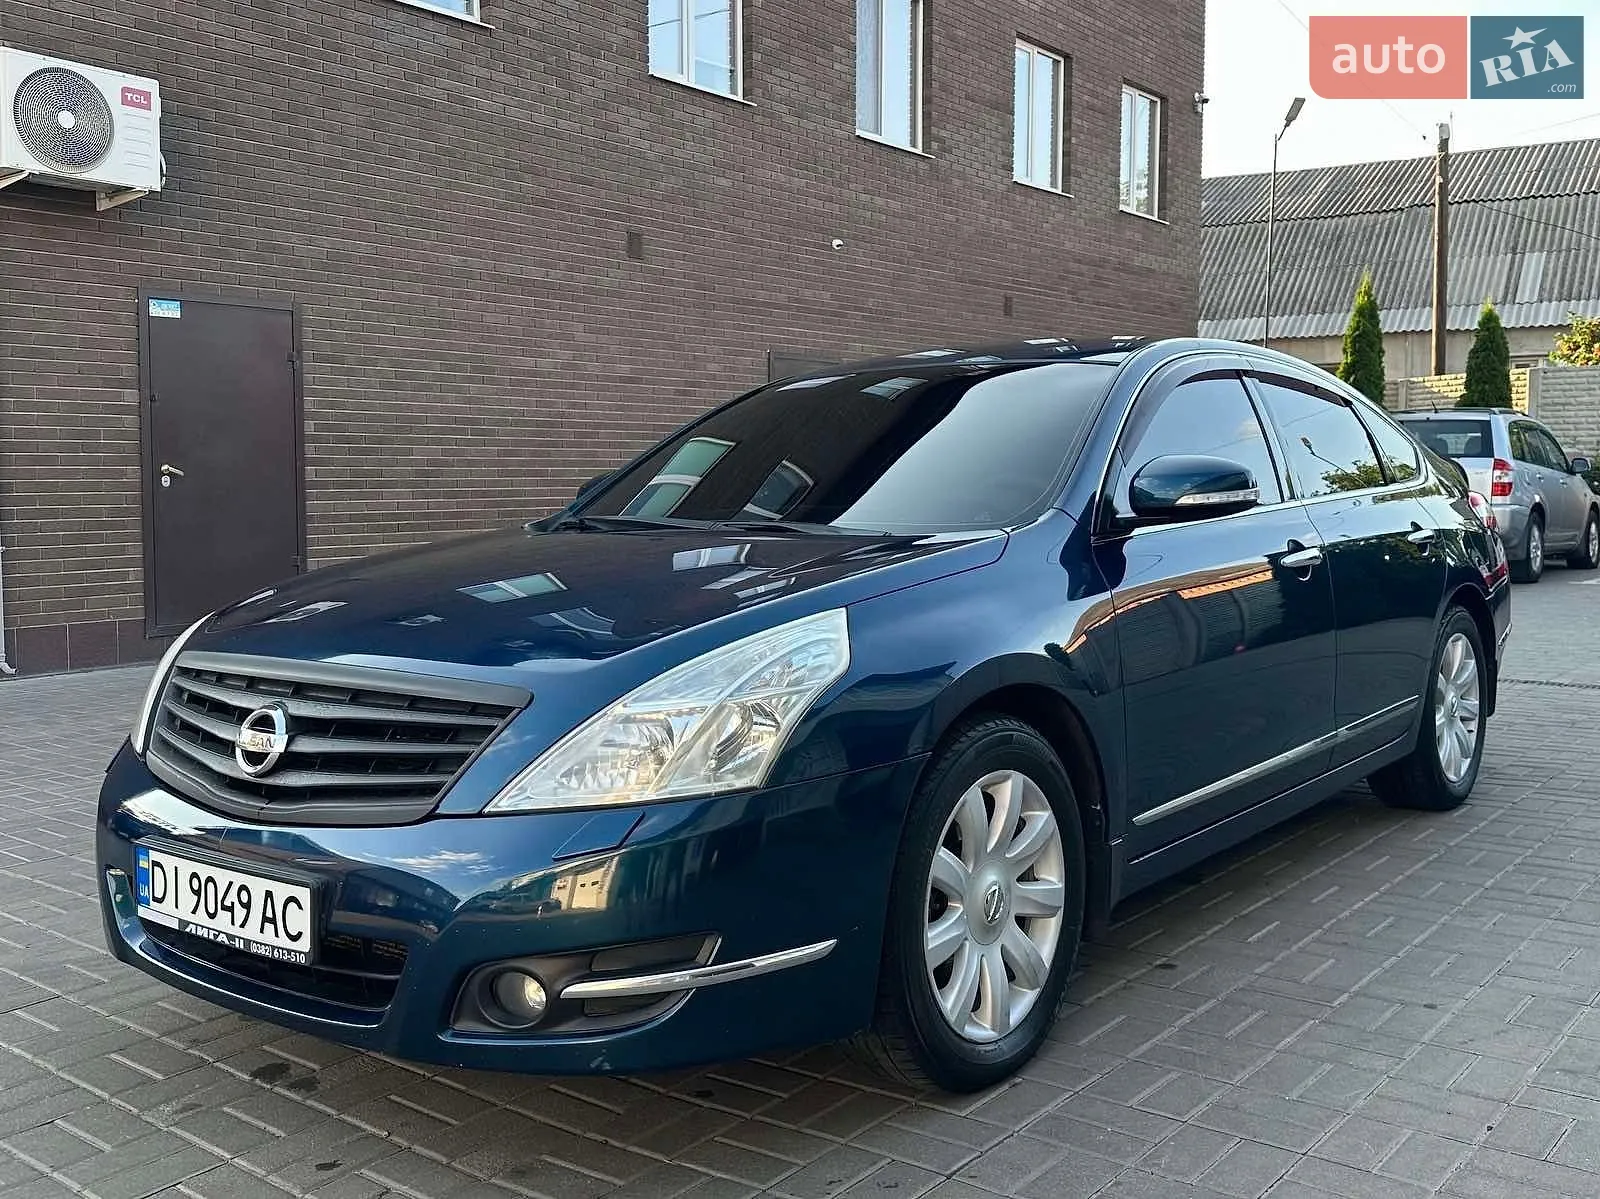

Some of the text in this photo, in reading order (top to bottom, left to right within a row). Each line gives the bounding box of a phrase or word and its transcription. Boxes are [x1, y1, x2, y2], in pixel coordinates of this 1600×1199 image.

[125, 92, 148, 105] TCL
[139, 883, 149, 897] UA
[151, 859, 304, 942] DI 9049 AC
[250, 940, 272, 958] (0382)
[273, 948, 305, 964] 613-510
